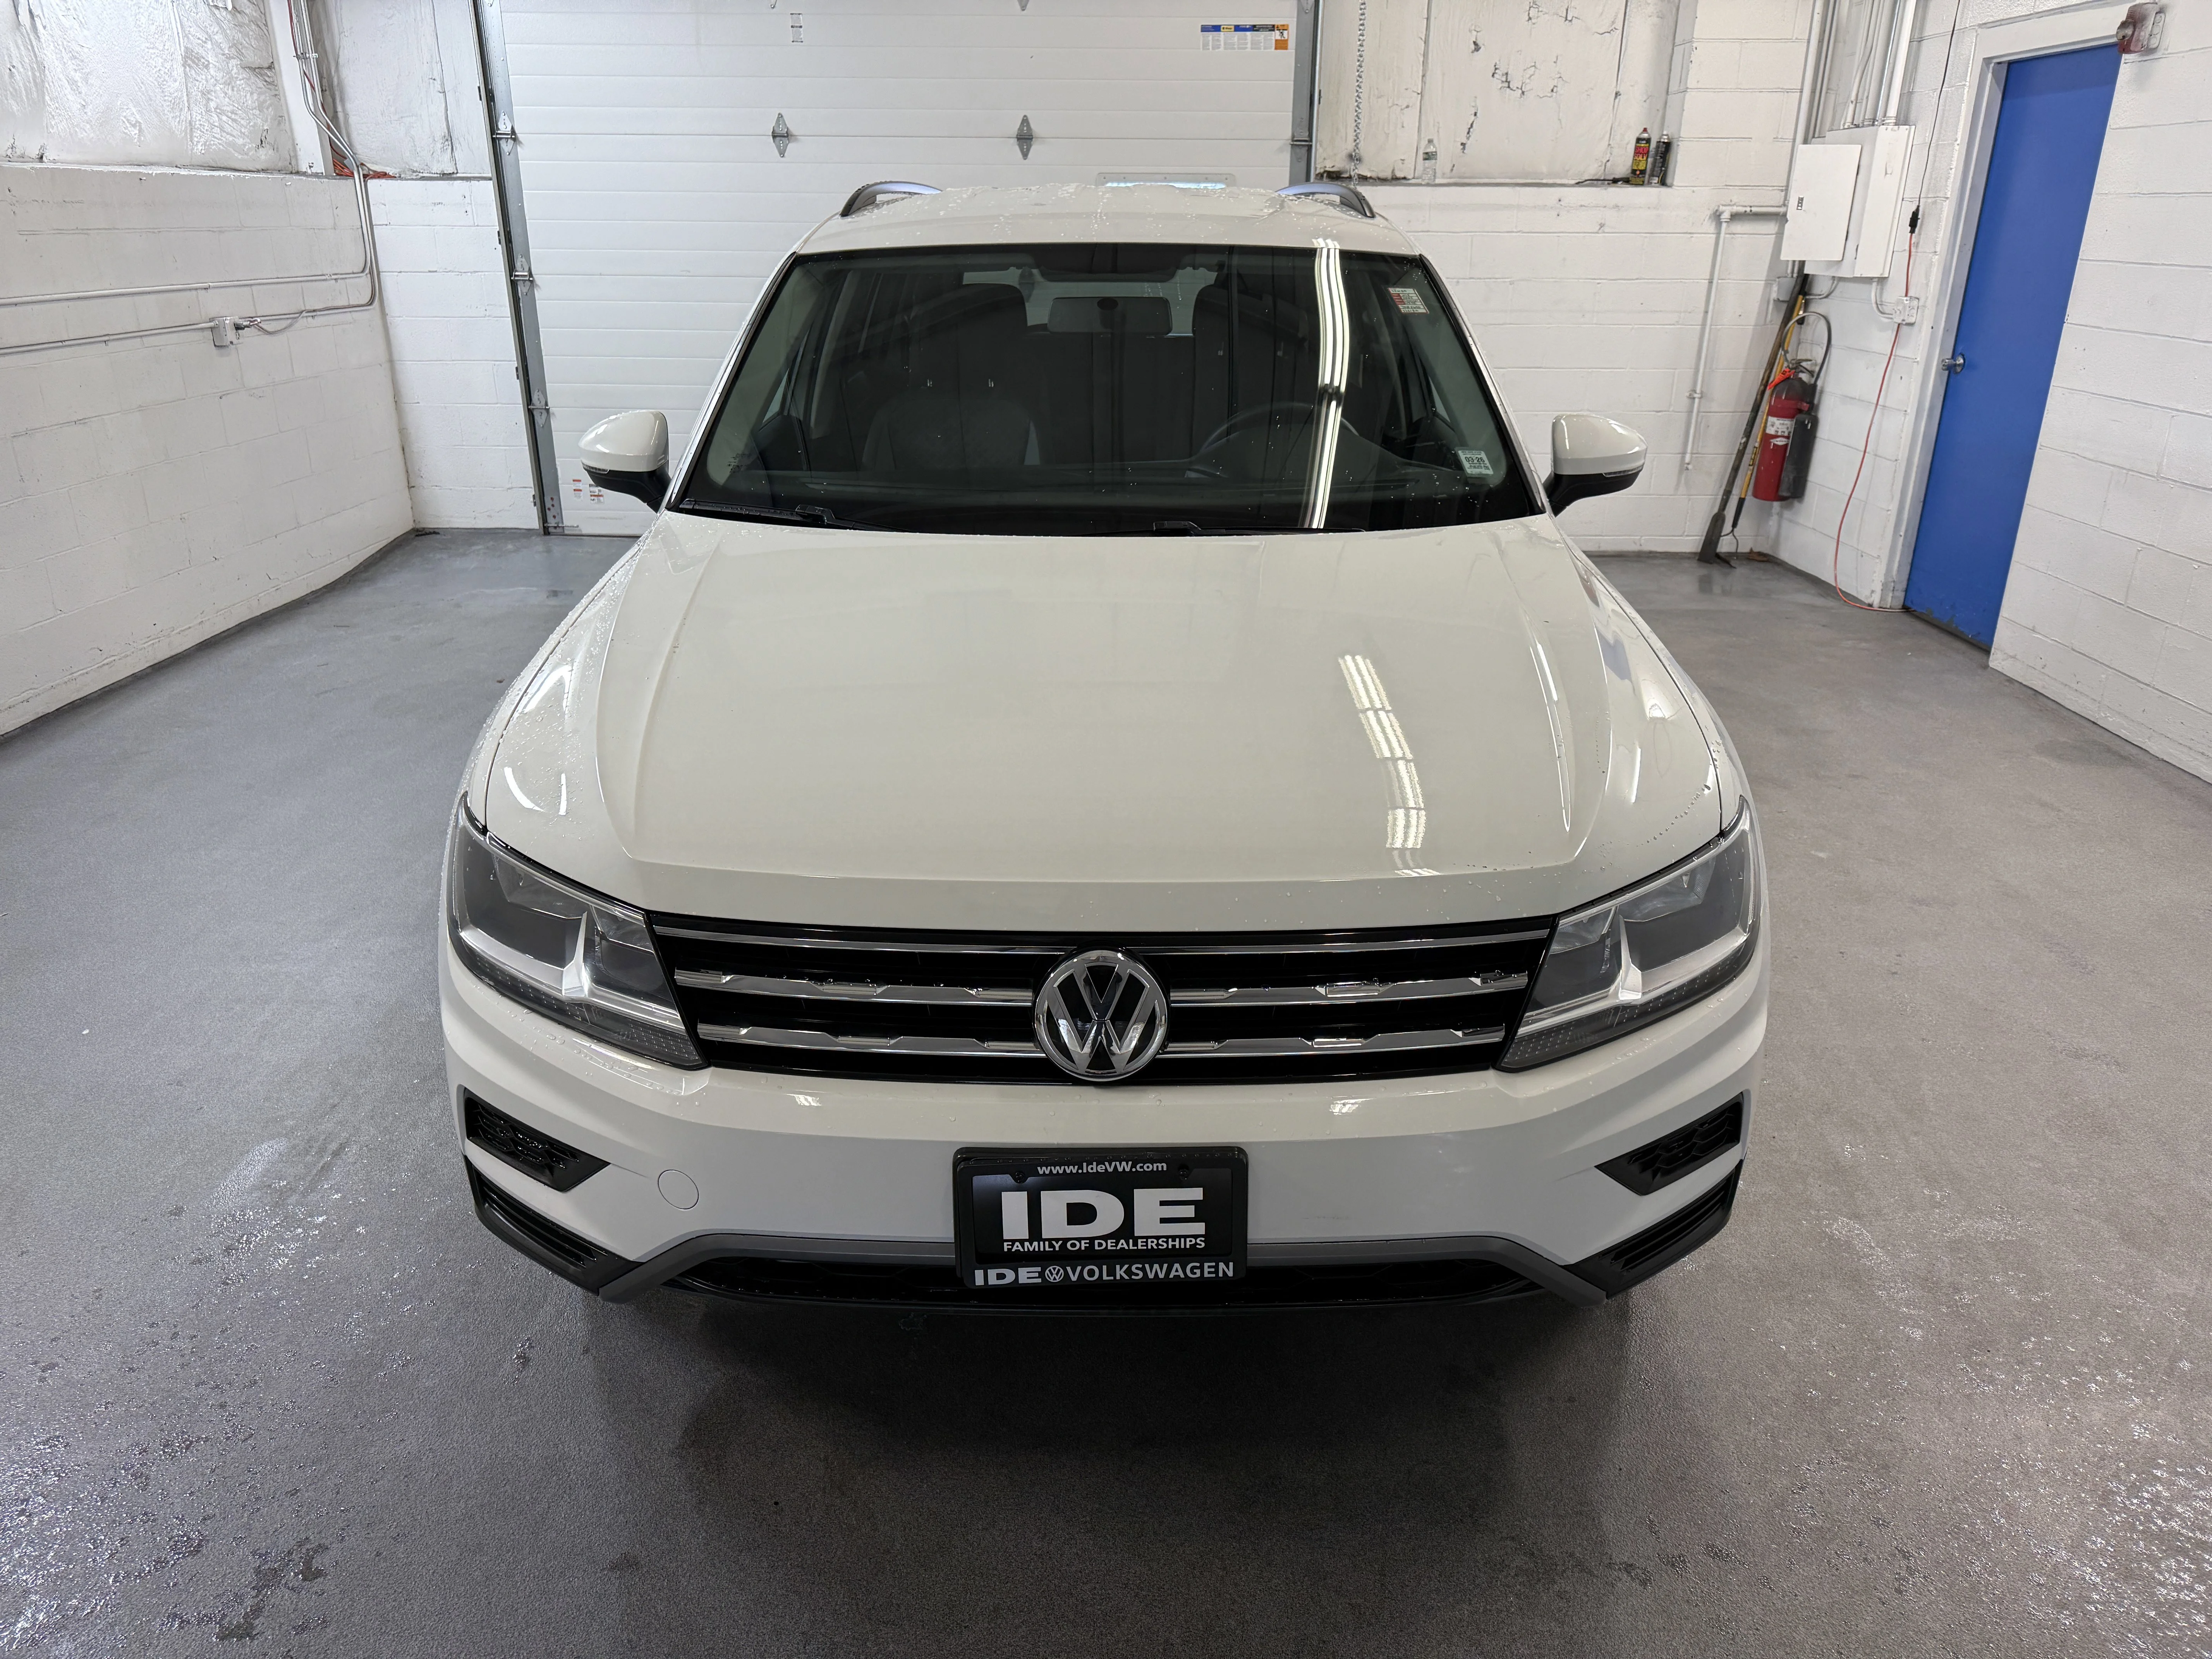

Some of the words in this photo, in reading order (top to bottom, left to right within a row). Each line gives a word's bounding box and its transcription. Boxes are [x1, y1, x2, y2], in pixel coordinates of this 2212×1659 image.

[1035, 951, 1168, 1080] VW
[1037, 1161, 1167, 1175] www.IdeVW.com
[1001, 1187, 1205, 1240] IDE
[1003, 1240, 1063, 1252] FAMILY
[1066, 1240, 1089, 1250] OF
[1094, 1237, 1205, 1250] DEALERSHIPS
[974, 1266, 1042, 1286] IDE
[1066, 1262, 1233, 1281] VOLKSWAGEN
